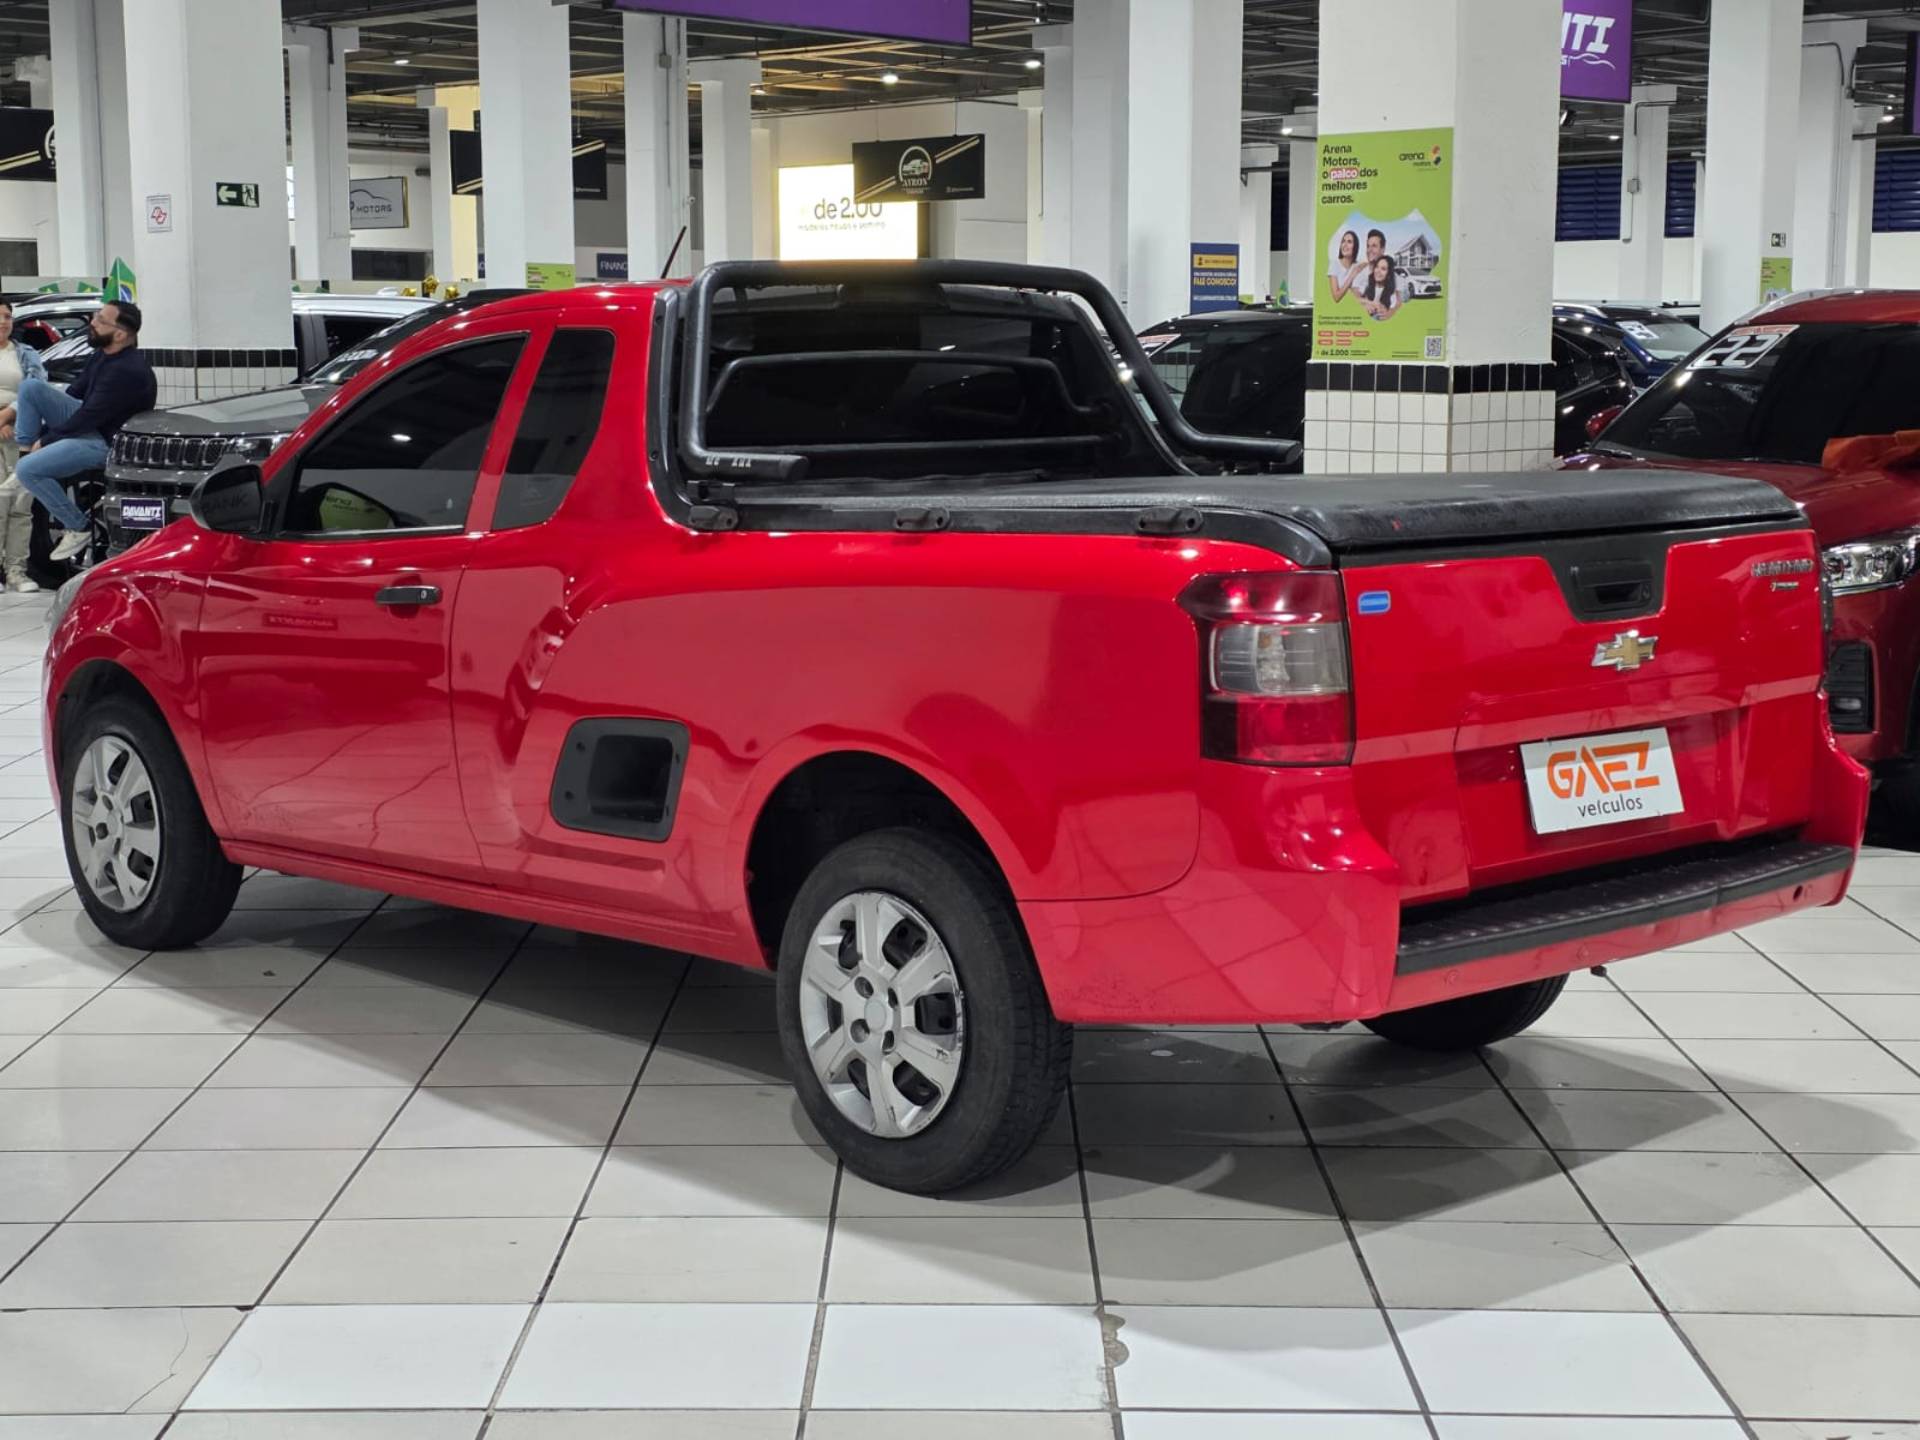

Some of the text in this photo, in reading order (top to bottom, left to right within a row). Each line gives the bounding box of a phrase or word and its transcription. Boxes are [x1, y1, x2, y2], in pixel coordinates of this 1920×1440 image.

[1323, 144, 1352, 154] Arena
[1323, 157, 1360, 167] Motors,
[1322, 168, 1378, 179] o palco dos
[1322, 181, 1367, 191] melhores
[1321, 195, 1354, 204] carros.
[814, 198, 837, 219] de
[1693, 334, 1781, 366] 22
